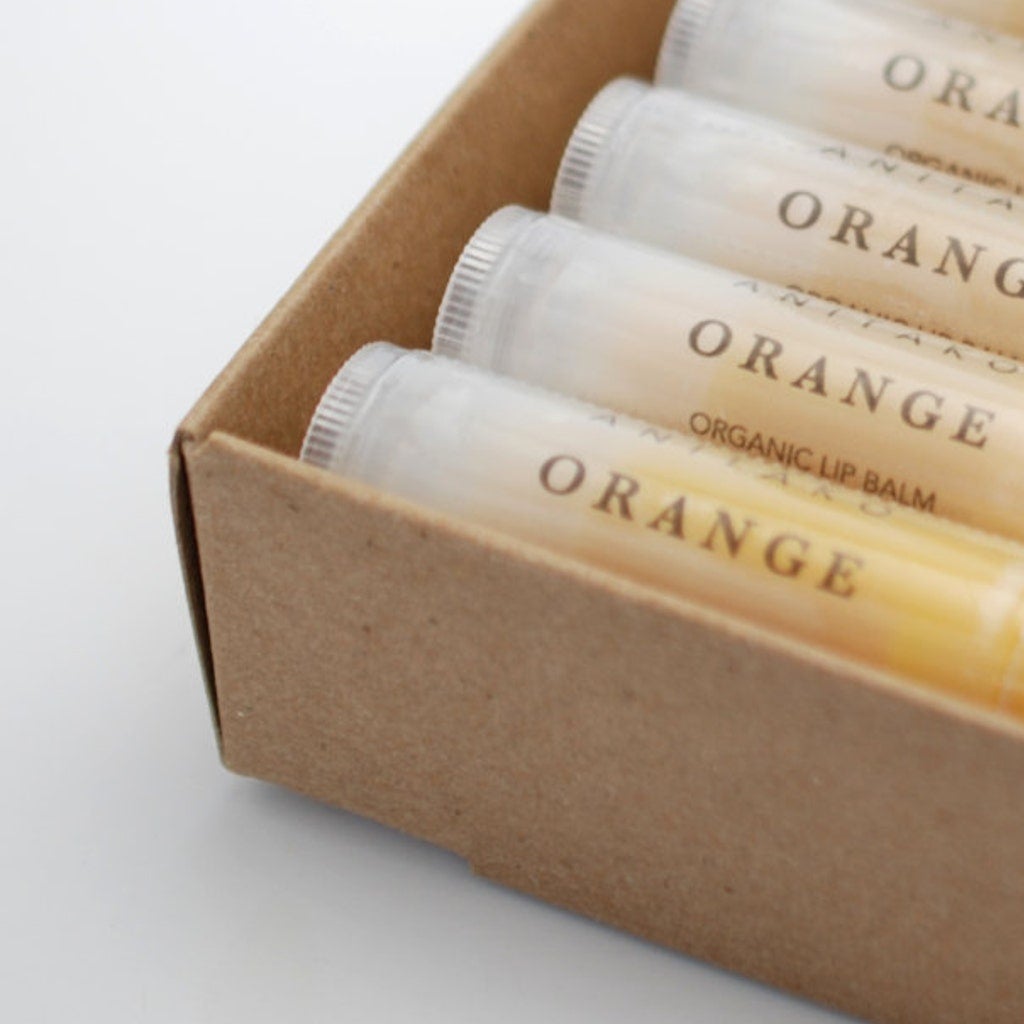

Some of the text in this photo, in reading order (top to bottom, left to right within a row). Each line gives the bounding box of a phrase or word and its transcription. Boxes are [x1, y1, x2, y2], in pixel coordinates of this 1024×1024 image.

[688, 319, 996, 449] ORANGE
[538, 454, 864, 599] ORANGE
[689, 411, 938, 513] ORGANIC LIP BALM
